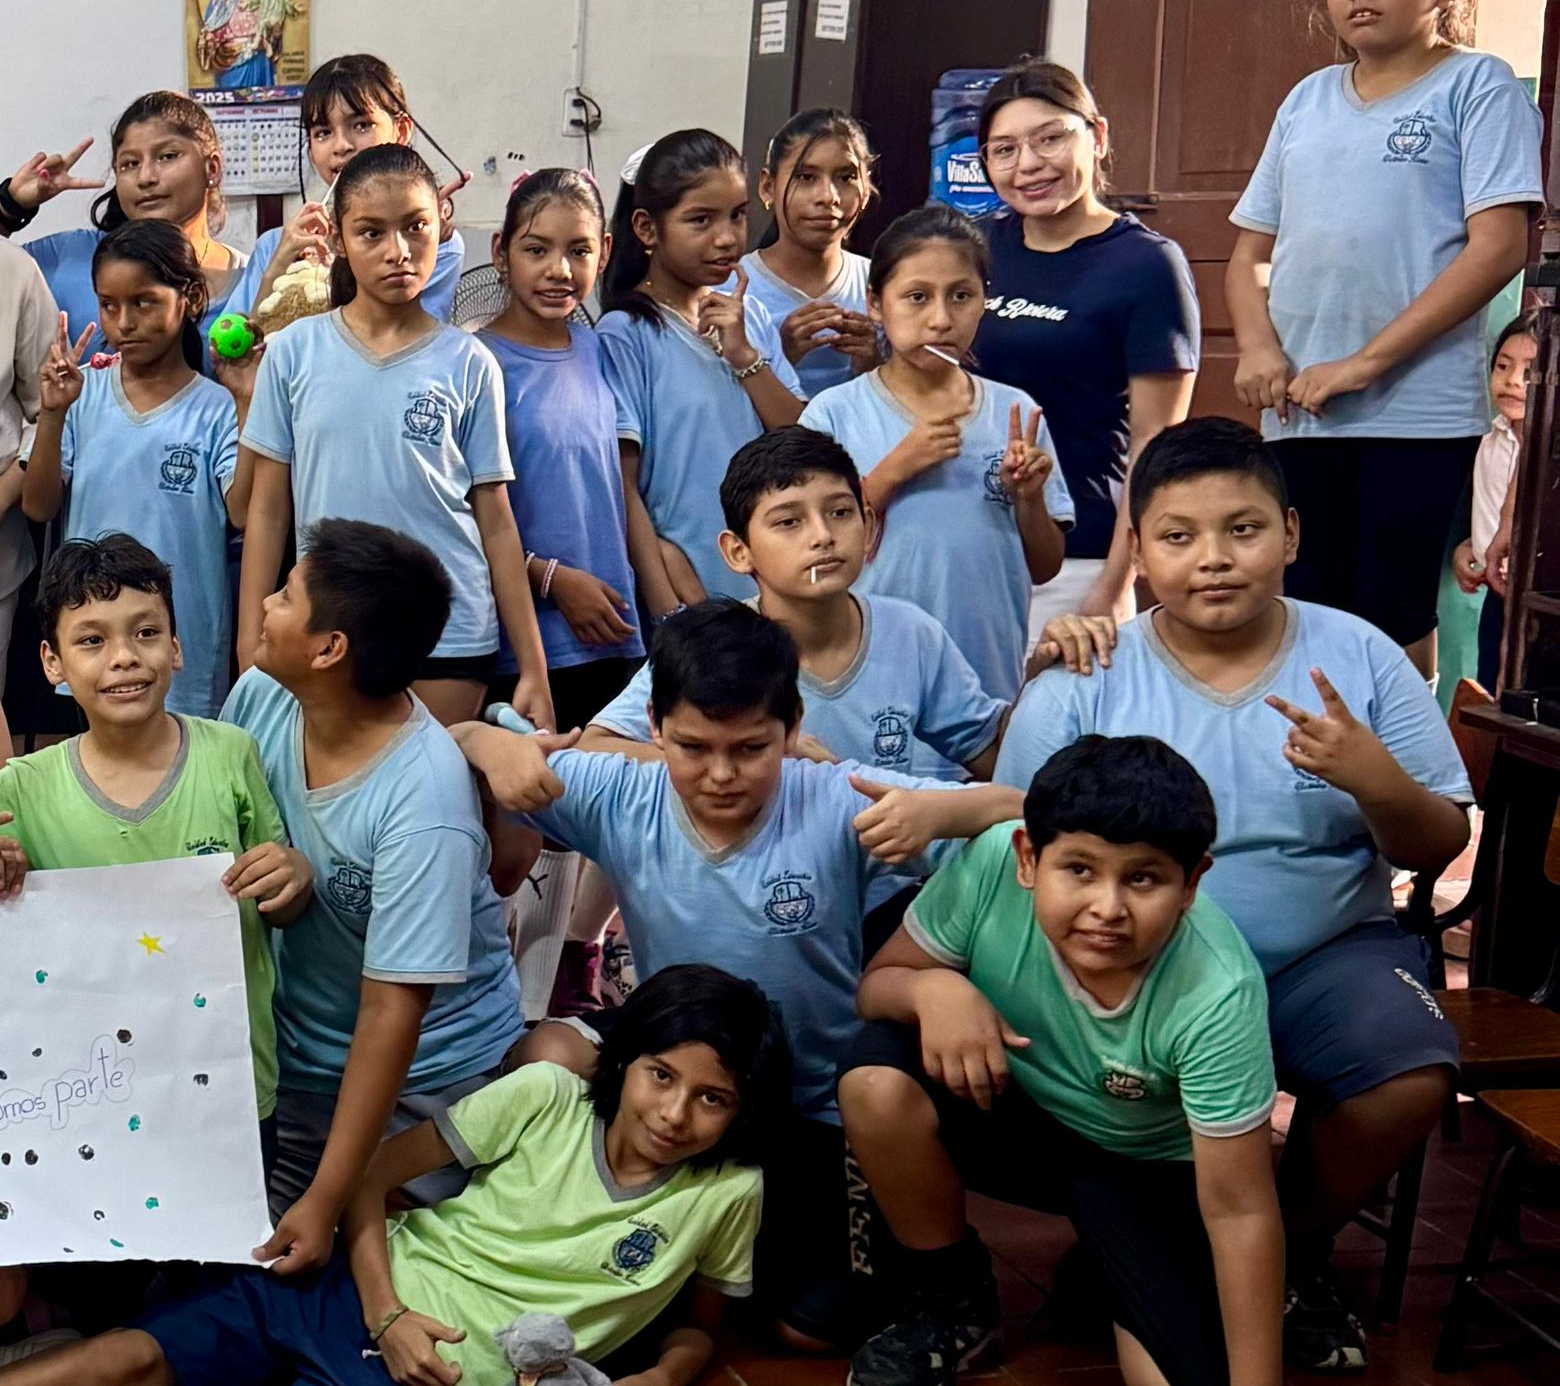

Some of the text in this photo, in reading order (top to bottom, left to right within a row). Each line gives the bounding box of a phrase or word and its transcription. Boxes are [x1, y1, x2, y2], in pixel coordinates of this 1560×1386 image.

[196, 92, 235, 103] 2025
[948, 160, 987, 183] VillaSa
[54, 1047, 124, 1122] parte
